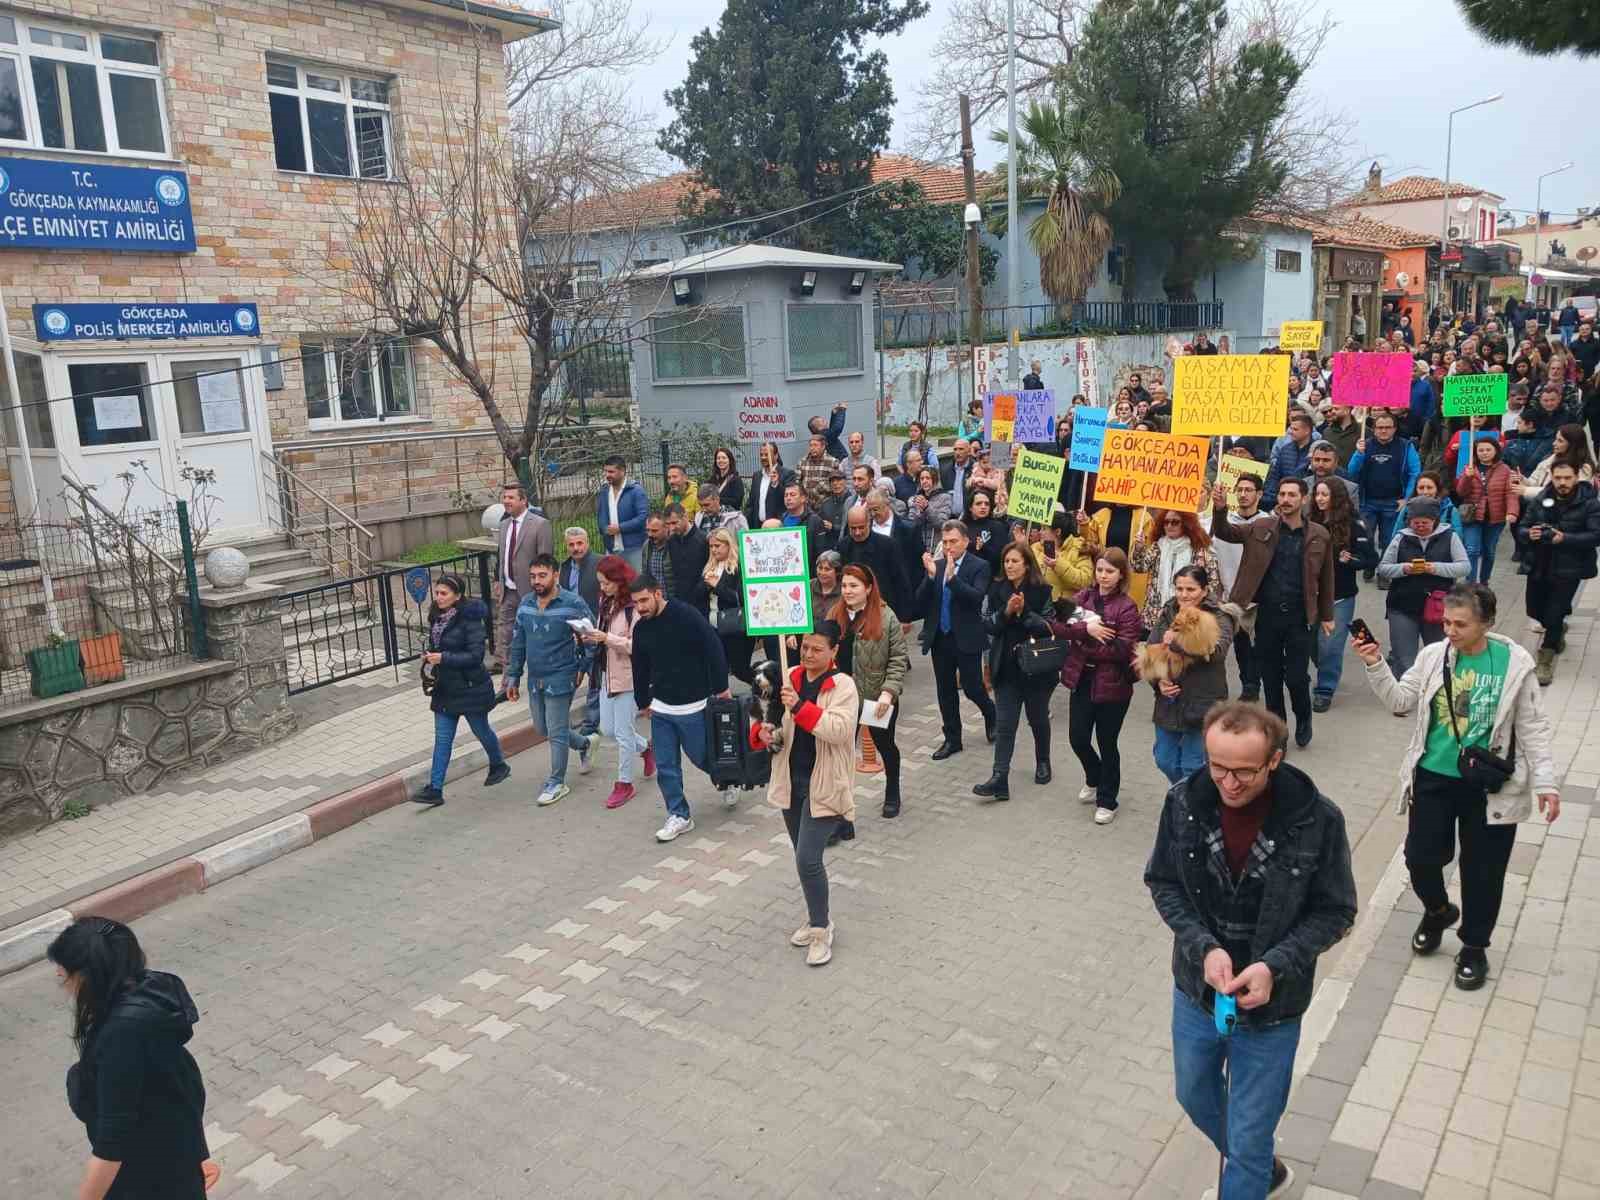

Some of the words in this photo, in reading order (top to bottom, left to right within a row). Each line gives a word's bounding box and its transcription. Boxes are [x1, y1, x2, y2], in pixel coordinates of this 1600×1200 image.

[72, 171, 98, 188] T.C.
[9, 189, 74, 213] GÖKÇEADA
[77, 196, 160, 215] KAYMAKAMLIĞI
[32, 214, 109, 238] EMNİYET
[115, 217, 186, 241] AMİRLİĞİ
[121, 306, 188, 321] GÖKÇEADA
[74, 321, 115, 337] POLİS
[118, 319, 177, 336] MERKEZİ
[179, 319, 233, 335] AMİRLİĞİ
[1182, 357, 1278, 375] YAŞAMAK
[1180, 407, 1222, 425] DAHA
[1111, 432, 1200, 459] GÖKÇEADA
[1102, 452, 1200, 480] HAYVANLARINA
[1019, 490, 1046, 505] YARIN
[1097, 474, 1137, 497] SAHİP
[1140, 481, 1198, 506] ÇIKIYOR
